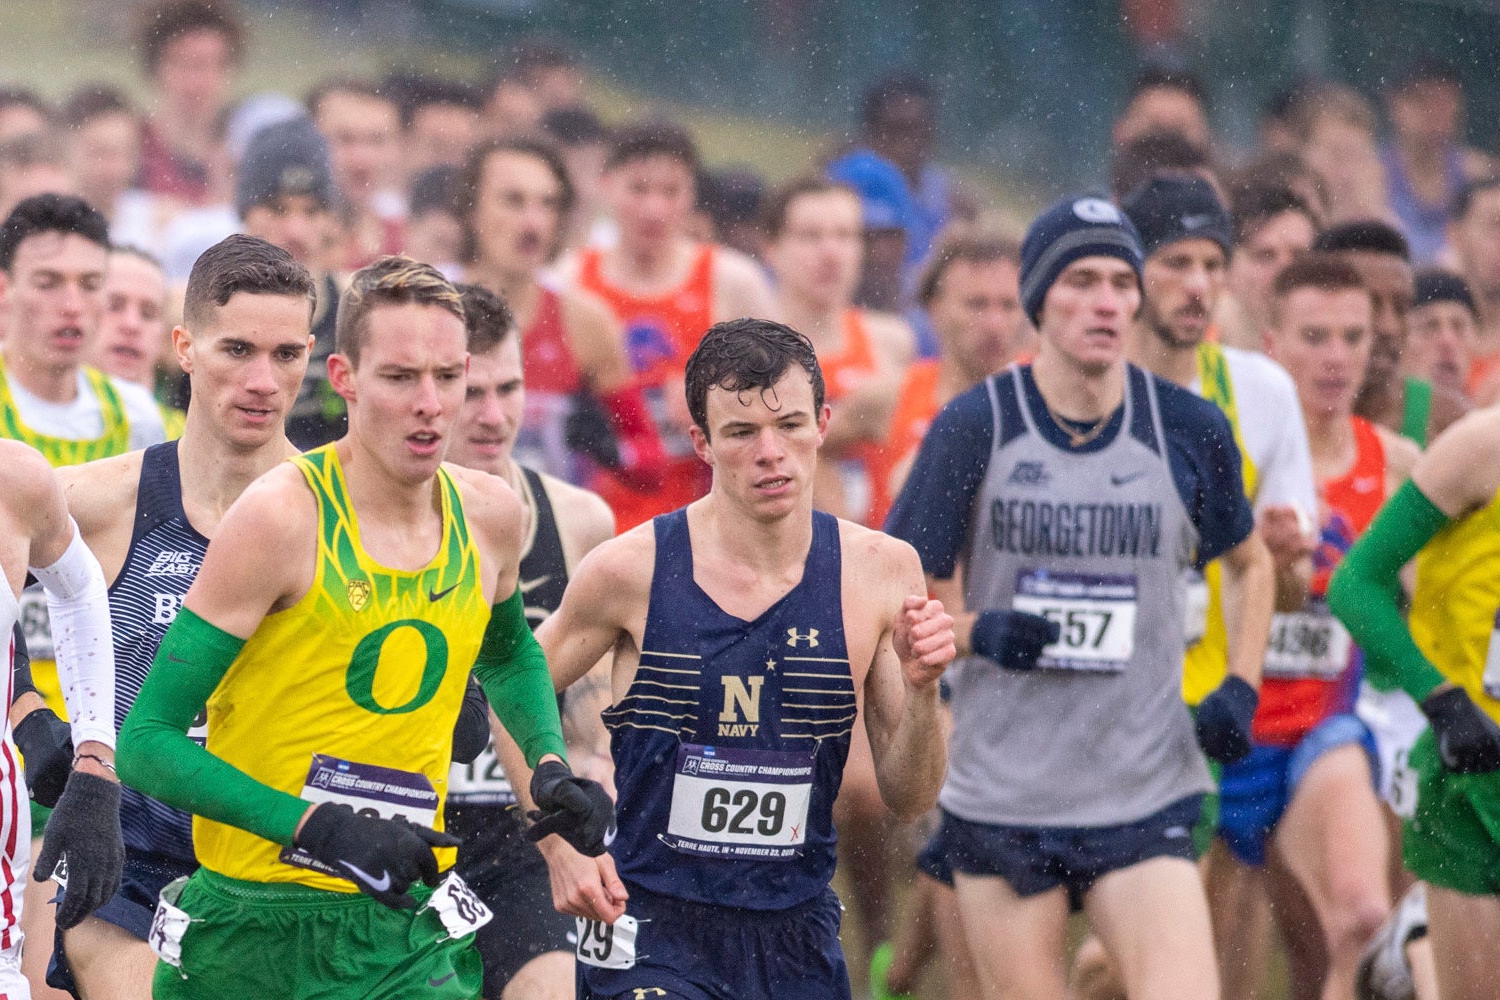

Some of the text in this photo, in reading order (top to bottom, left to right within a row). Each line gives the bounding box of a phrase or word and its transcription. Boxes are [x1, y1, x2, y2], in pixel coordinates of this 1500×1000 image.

[991, 498, 1161, 557] GEORGETOWN
[155, 550, 193, 563] BIG
[149, 562, 202, 574] EAST
[345, 619, 449, 716] O
[719, 675, 764, 722] N
[717, 724, 760, 737] NAVY
[700, 762, 725, 772] CROSS
[725, 764, 758, 774] COUNTRY
[758, 766, 812, 776] CHAMPIONSHIPS
[331, 776, 355, 788] CROSS
[355, 779, 386, 792] COUNTRY
[384, 784, 437, 800] CHAMPIONSHIPS
[701, 787, 786, 836] 629
[678, 840, 698, 849] TERRE
[698, 843, 720, 853] HAUTE,
[721, 845, 730, 854] IN
[735, 846, 770, 856] NOVEMBER
[291, 853, 311, 866] TERRE
